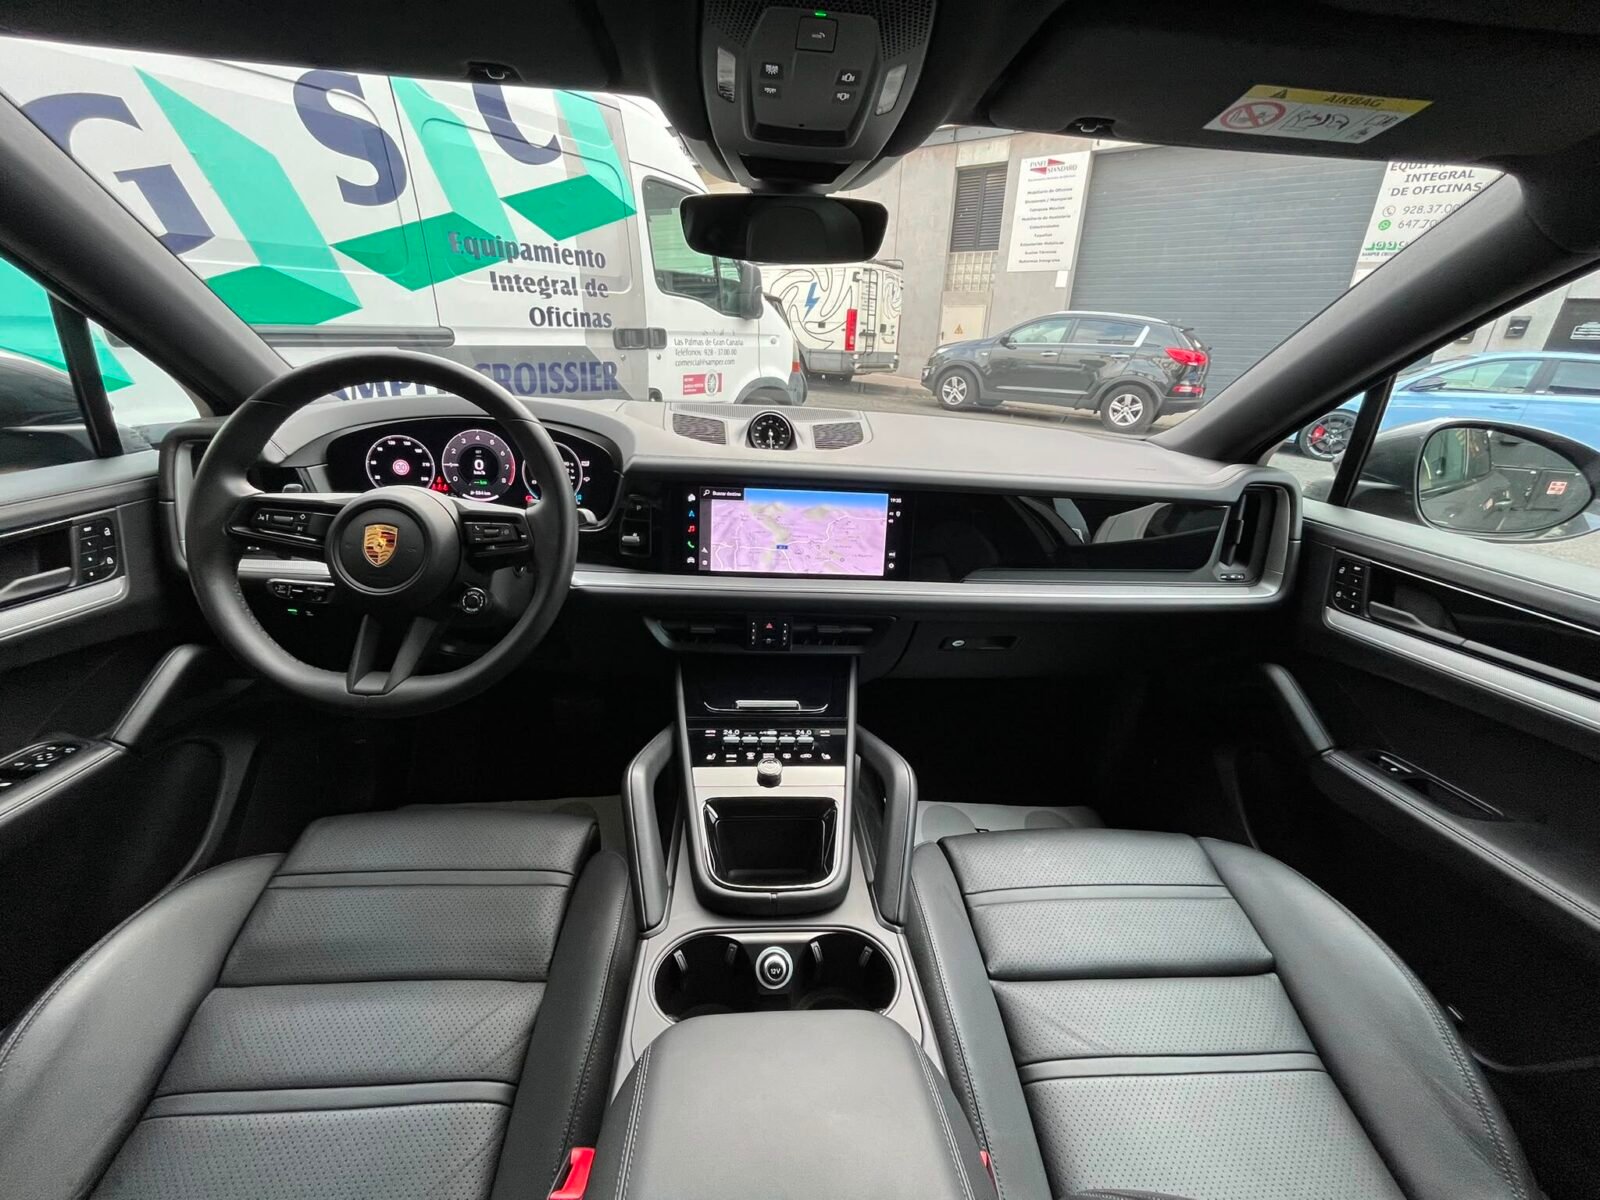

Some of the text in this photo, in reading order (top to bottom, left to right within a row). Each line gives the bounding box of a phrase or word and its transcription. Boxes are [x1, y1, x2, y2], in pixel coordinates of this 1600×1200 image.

[1325, 94, 1385, 108] AIRBAG
[1404, 169, 1475, 183] INTEGRAL
[1390, 182, 1483, 197] DE OFICINAS
[448, 231, 607, 269] Equipamiento
[489, 270, 609, 299] Integral de
[529, 305, 613, 329] Oficinas
[673, 338, 684, 346] Las
[685, 338, 704, 346] Palmas
[705, 338, 712, 346] de
[474, 459, 484, 470] 0
